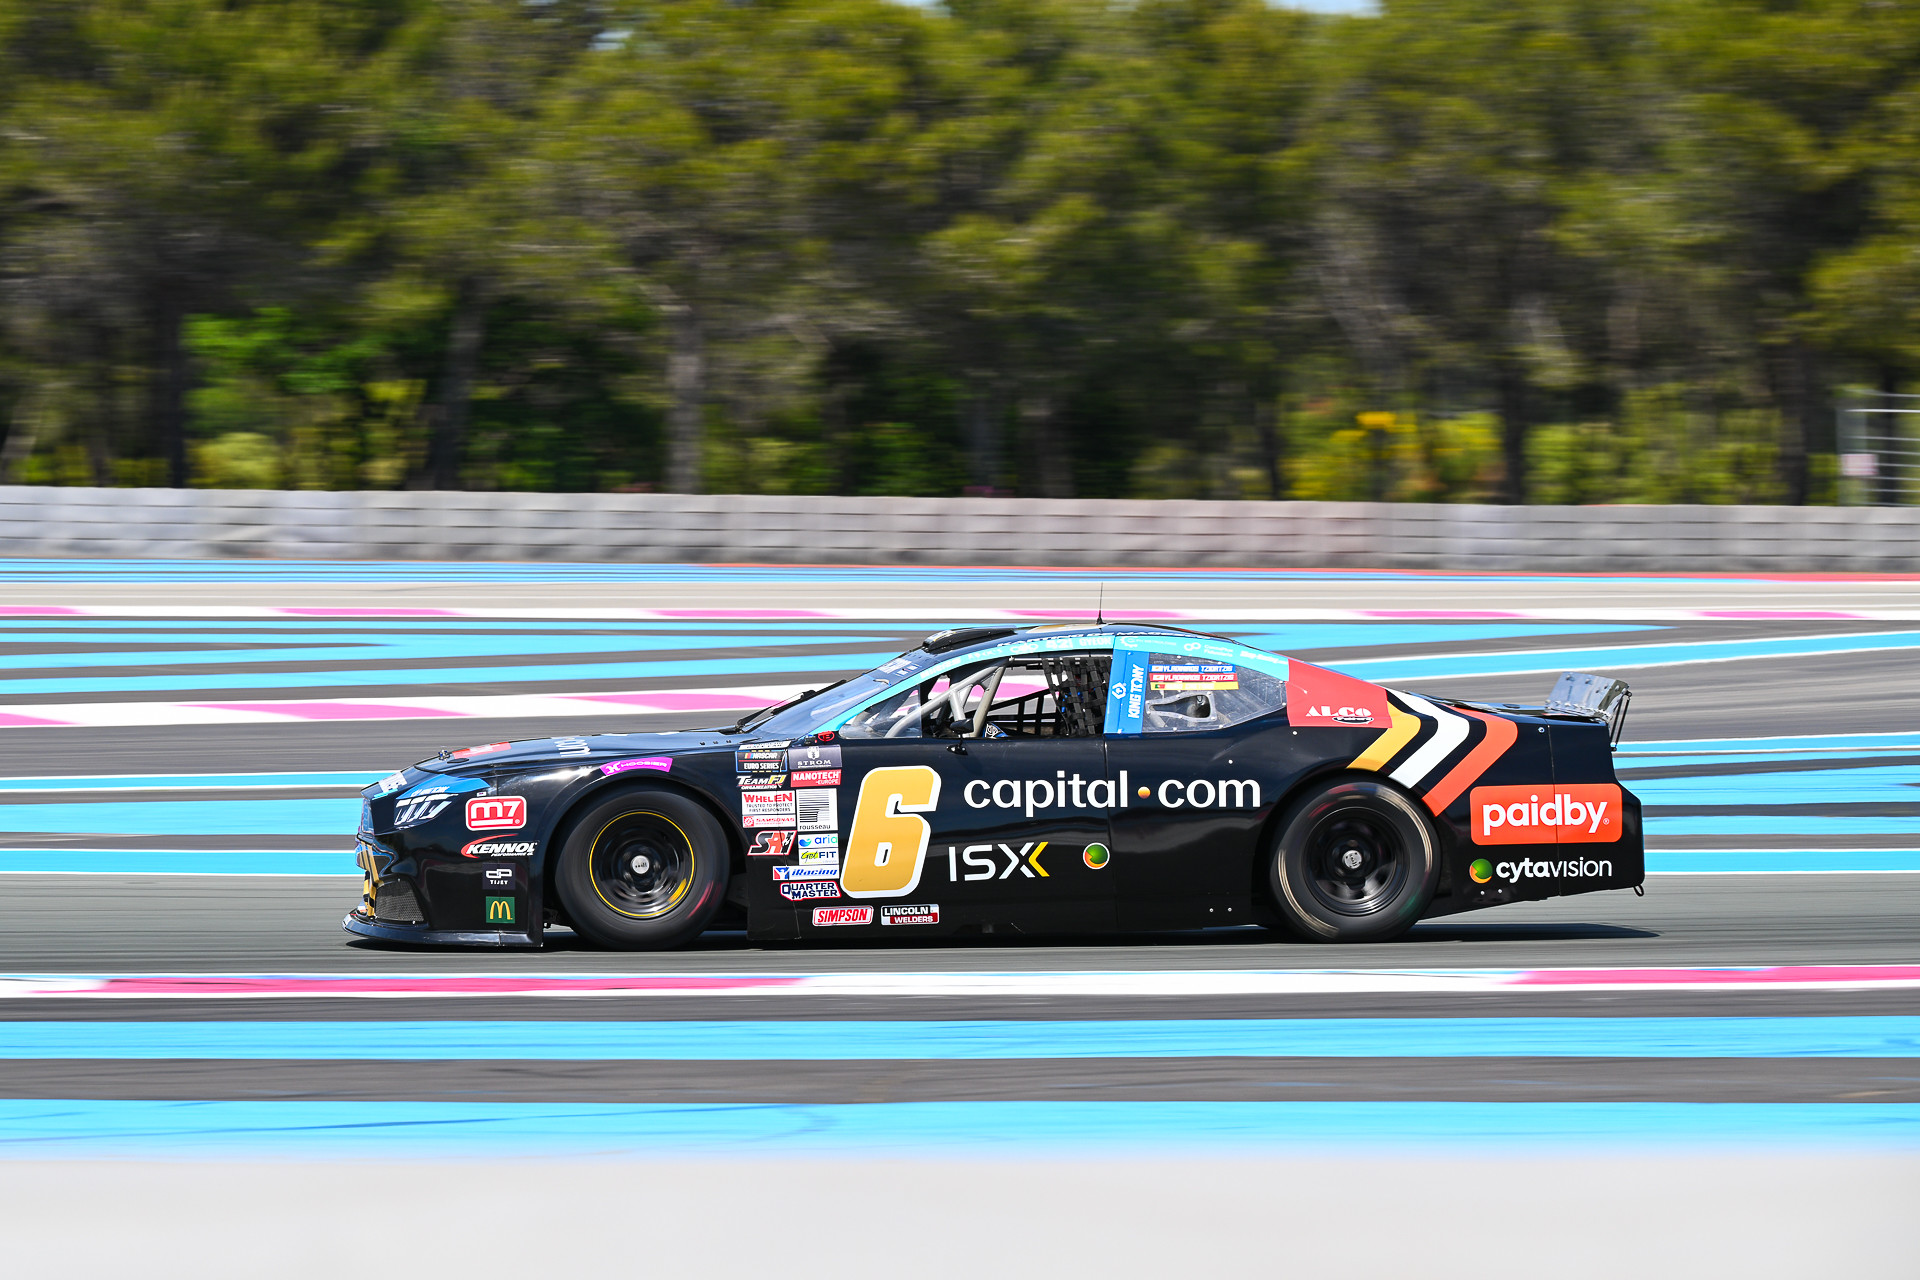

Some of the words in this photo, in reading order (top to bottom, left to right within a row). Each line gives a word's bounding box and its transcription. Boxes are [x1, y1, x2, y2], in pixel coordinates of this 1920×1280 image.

[1130, 663, 1145, 693] TONY
[1127, 693, 1142, 719] KING
[1305, 705, 1372, 717] ALCO
[620, 760, 668, 768] HOOSIER
[760, 762, 780, 770] SERIES
[792, 771, 839, 781] NANOTECH
[743, 792, 793, 803] WHELEN
[840, 765, 942, 899] 6
[814, 834, 838, 845] aria
[465, 842, 535, 855] KENNOL
[791, 868, 838, 877] iRacing
[1495, 856, 1612, 884] cytavision
[781, 882, 835, 895] QUARTER
[791, 889, 838, 899] MASTER
[817, 908, 868, 923] SIMPSON
[884, 906, 929, 916] LINCOLN
[893, 915, 934, 924] WELDERS
